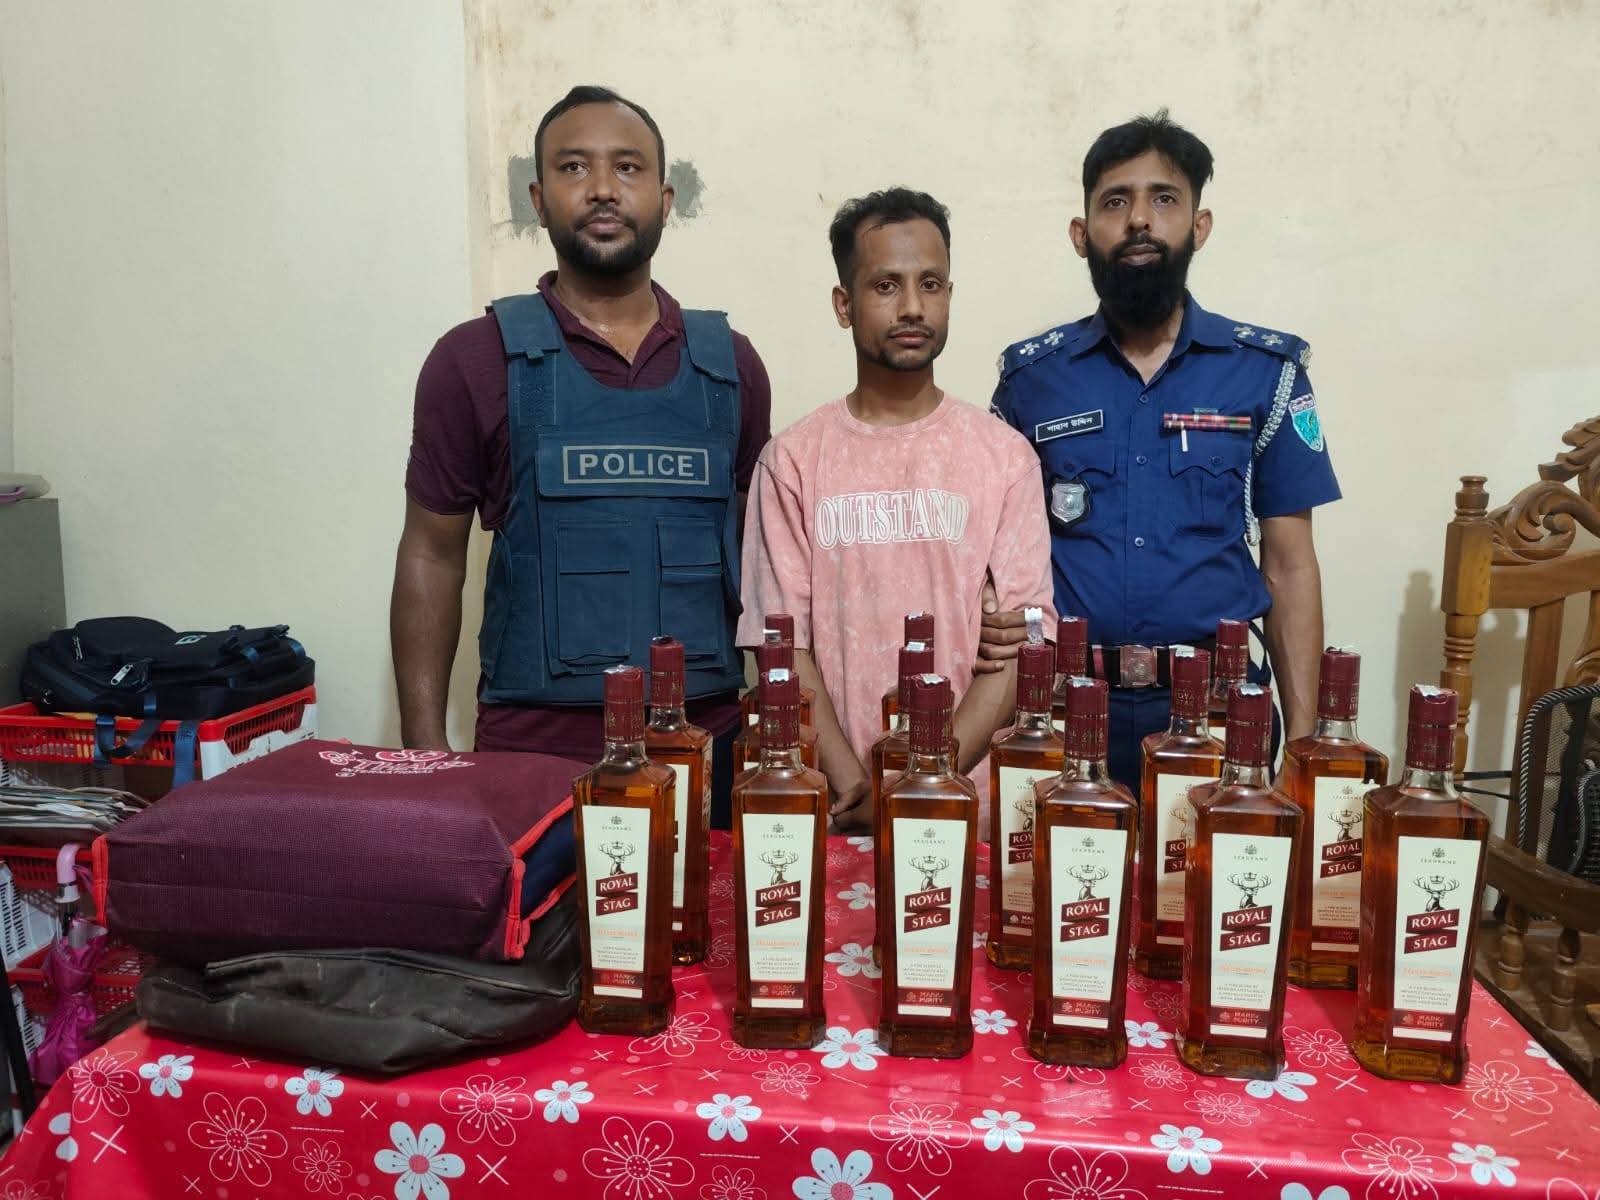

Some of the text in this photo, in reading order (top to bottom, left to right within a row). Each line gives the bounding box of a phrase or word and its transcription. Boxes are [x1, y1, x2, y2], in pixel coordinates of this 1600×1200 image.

[578, 453, 695, 478] POLICE
[815, 489, 969, 550] OUTSTAND
[1012, 834, 1033, 844] ROY
[1016, 851, 1033, 861] STA
[1326, 842, 1361, 857] ROYAL
[1327, 861, 1356, 874] STAG
[600, 877, 634, 892] ROYAL
[760, 885, 797, 902] ROYAL
[909, 892, 948, 908] ROYAL
[603, 898, 631, 911] STAG
[1066, 902, 1105, 917] ROYAL
[763, 907, 793, 922] STAG
[912, 914, 943, 928] STAG
[1226, 911, 1268, 925] ROYAL
[1411, 914, 1454, 929] ROYAL
[1068, 923, 1100, 938] STAG
[1229, 932, 1261, 946] STAG
[1413, 936, 1448, 949] STAG
